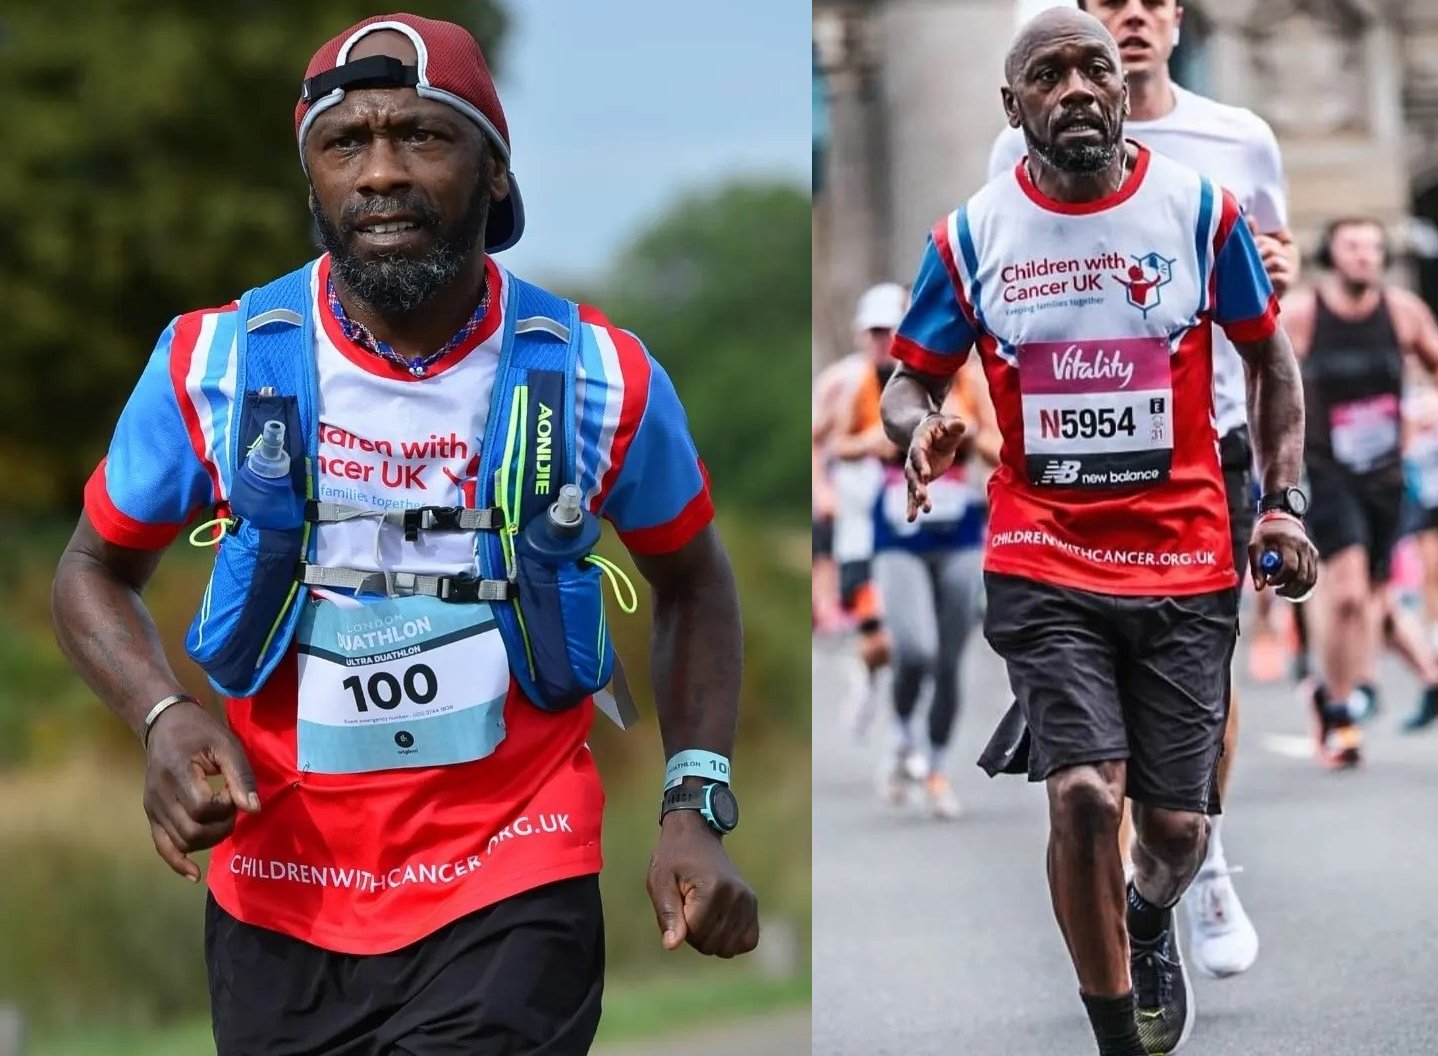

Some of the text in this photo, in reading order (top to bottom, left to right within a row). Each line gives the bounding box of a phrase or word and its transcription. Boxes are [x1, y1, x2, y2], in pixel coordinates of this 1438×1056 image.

[1001, 252, 1126, 284] Children with
[1003, 273, 1103, 303] Cancer UK
[1051, 344, 1135, 388] Vitality
[1040, 406, 1137, 439] N5954
[319, 422, 469, 460] ldren with
[535, 402, 553, 495] AONIJIE
[317, 455, 427, 490] ncer UK
[1082, 472, 1107, 484] new
[1110, 469, 1160, 483] balance
[321, 484, 368, 501] families
[992, 531, 1217, 566] CHILDRENWITHCANCER.ORG.UK
[337, 616, 433, 652] DUATHLON
[346, 614, 403, 633] LONDON
[346, 645, 421, 667] ULTRA DUATHLON
[342, 663, 438, 712] 100
[709, 760, 730, 775] 10
[229, 813, 573, 894] CHILDRENWITHCANCERORG.UK
